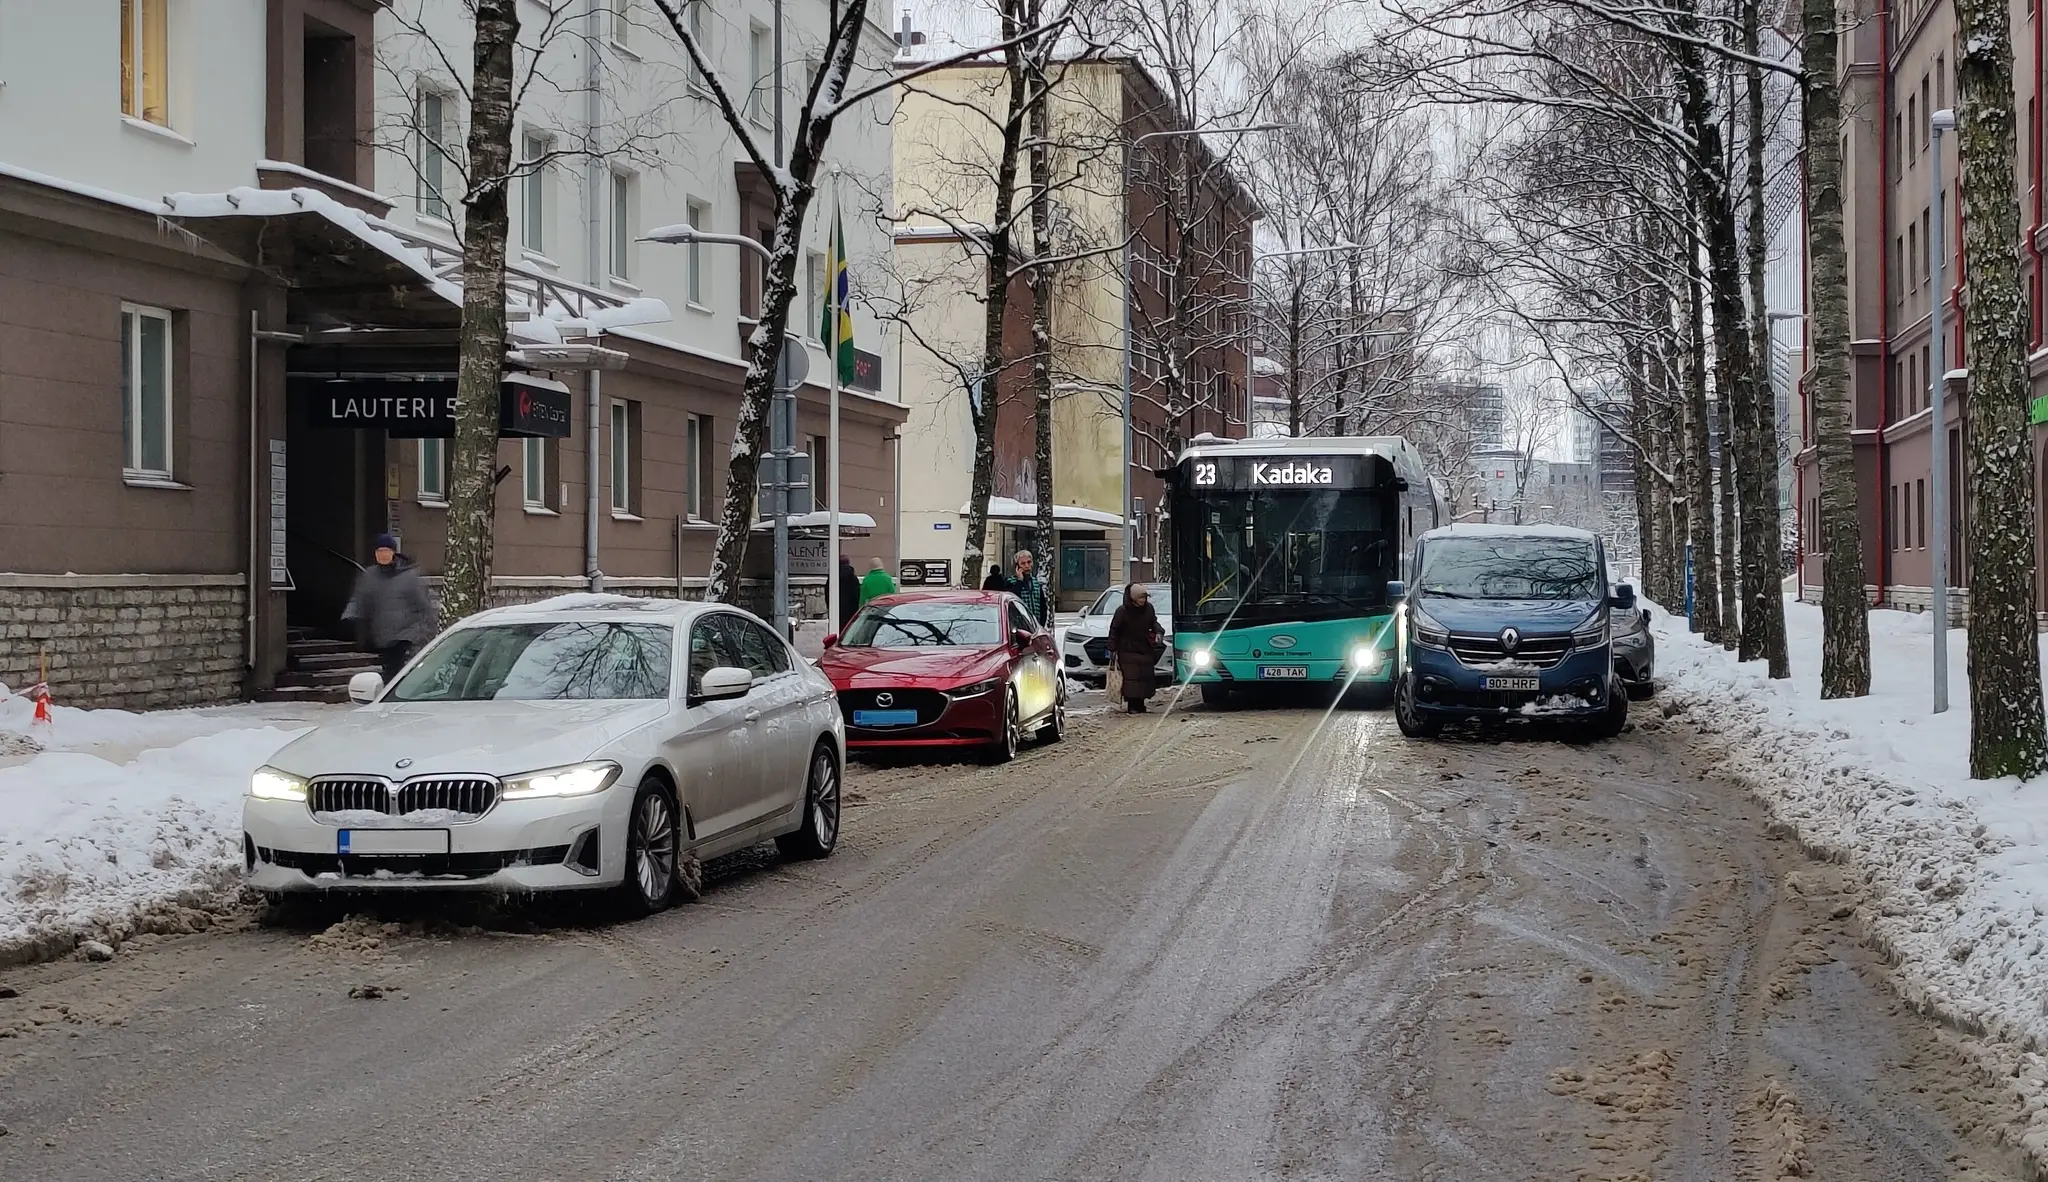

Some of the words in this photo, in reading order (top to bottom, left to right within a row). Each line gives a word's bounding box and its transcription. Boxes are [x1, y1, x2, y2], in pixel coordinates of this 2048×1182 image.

[331, 397, 435, 419] LAUTERI
[1195, 463, 1216, 485] 23
[1253, 462, 1333, 485] Kadaka
[788, 546, 828, 558] ALENTE
[1266, 668, 1281, 676] 428
[1286, 668, 1304, 676] TAK
[1512, 679, 1537, 688] HRF
